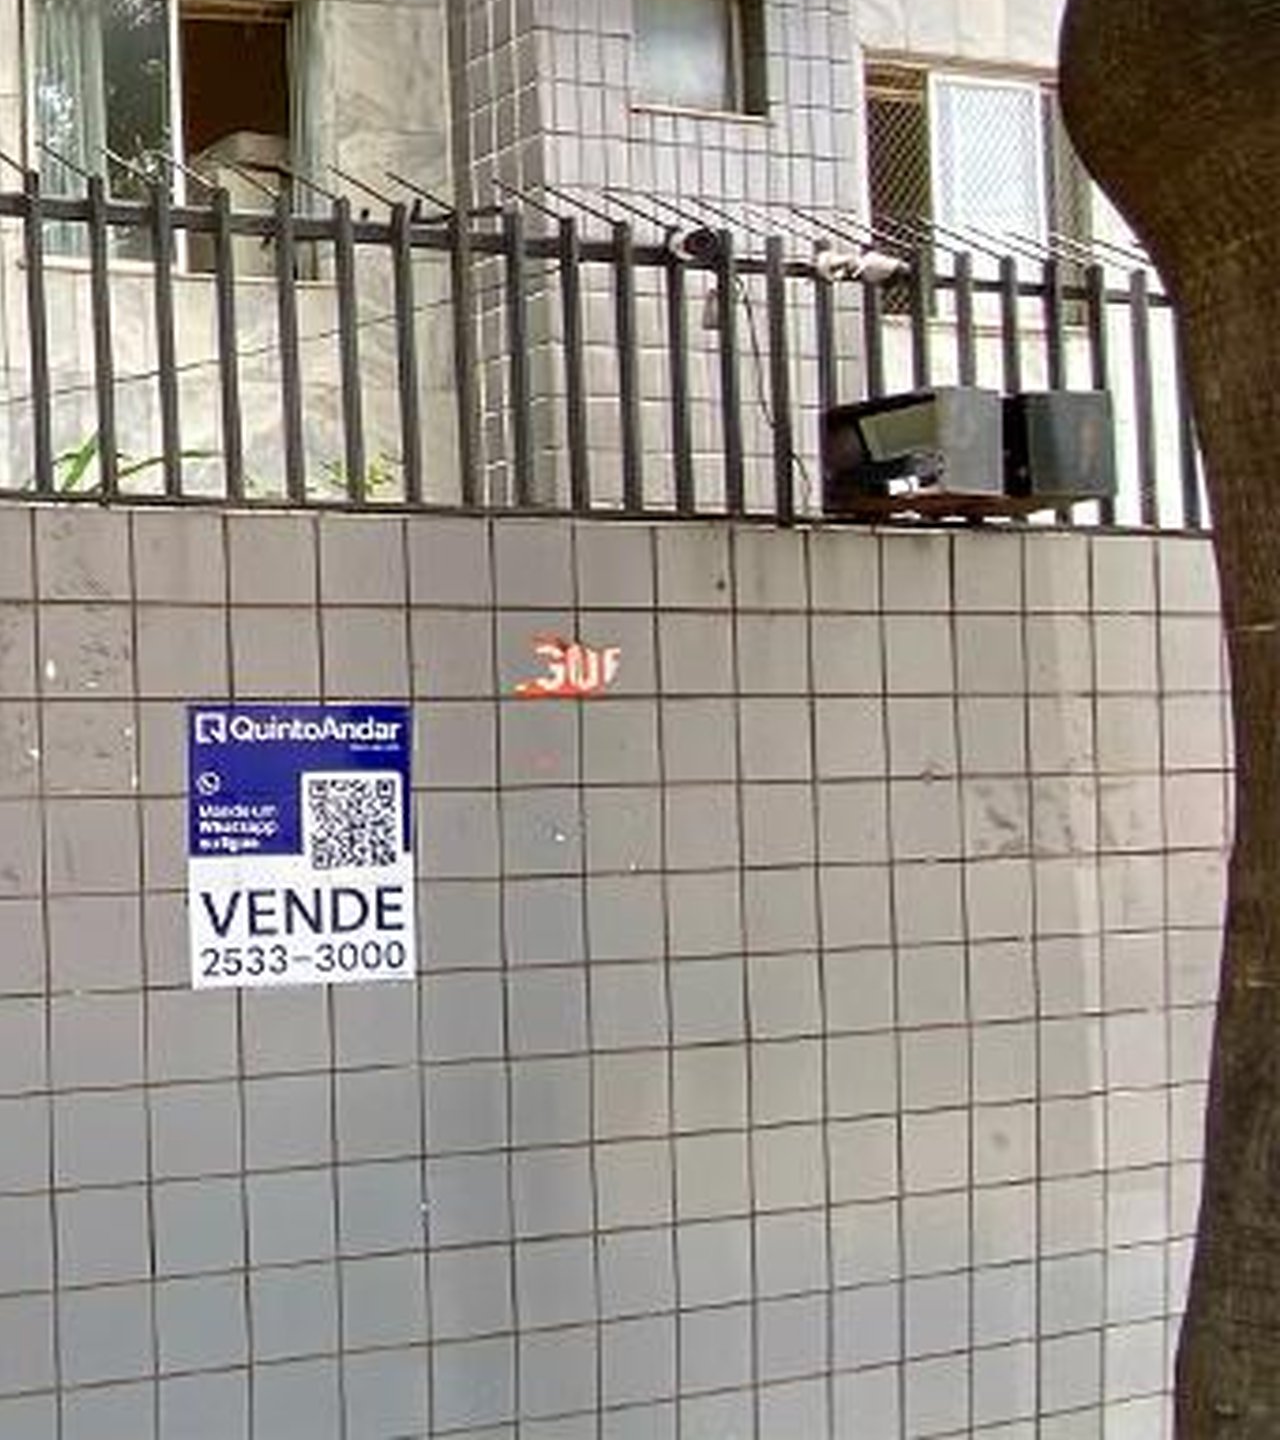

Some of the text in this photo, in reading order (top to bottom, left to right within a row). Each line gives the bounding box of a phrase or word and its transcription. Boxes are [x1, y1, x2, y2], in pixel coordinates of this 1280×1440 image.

[229, 714, 402, 742] QuintoAndar
[200, 886, 404, 938] VENDE
[200, 940, 406, 977] 2533-3000
